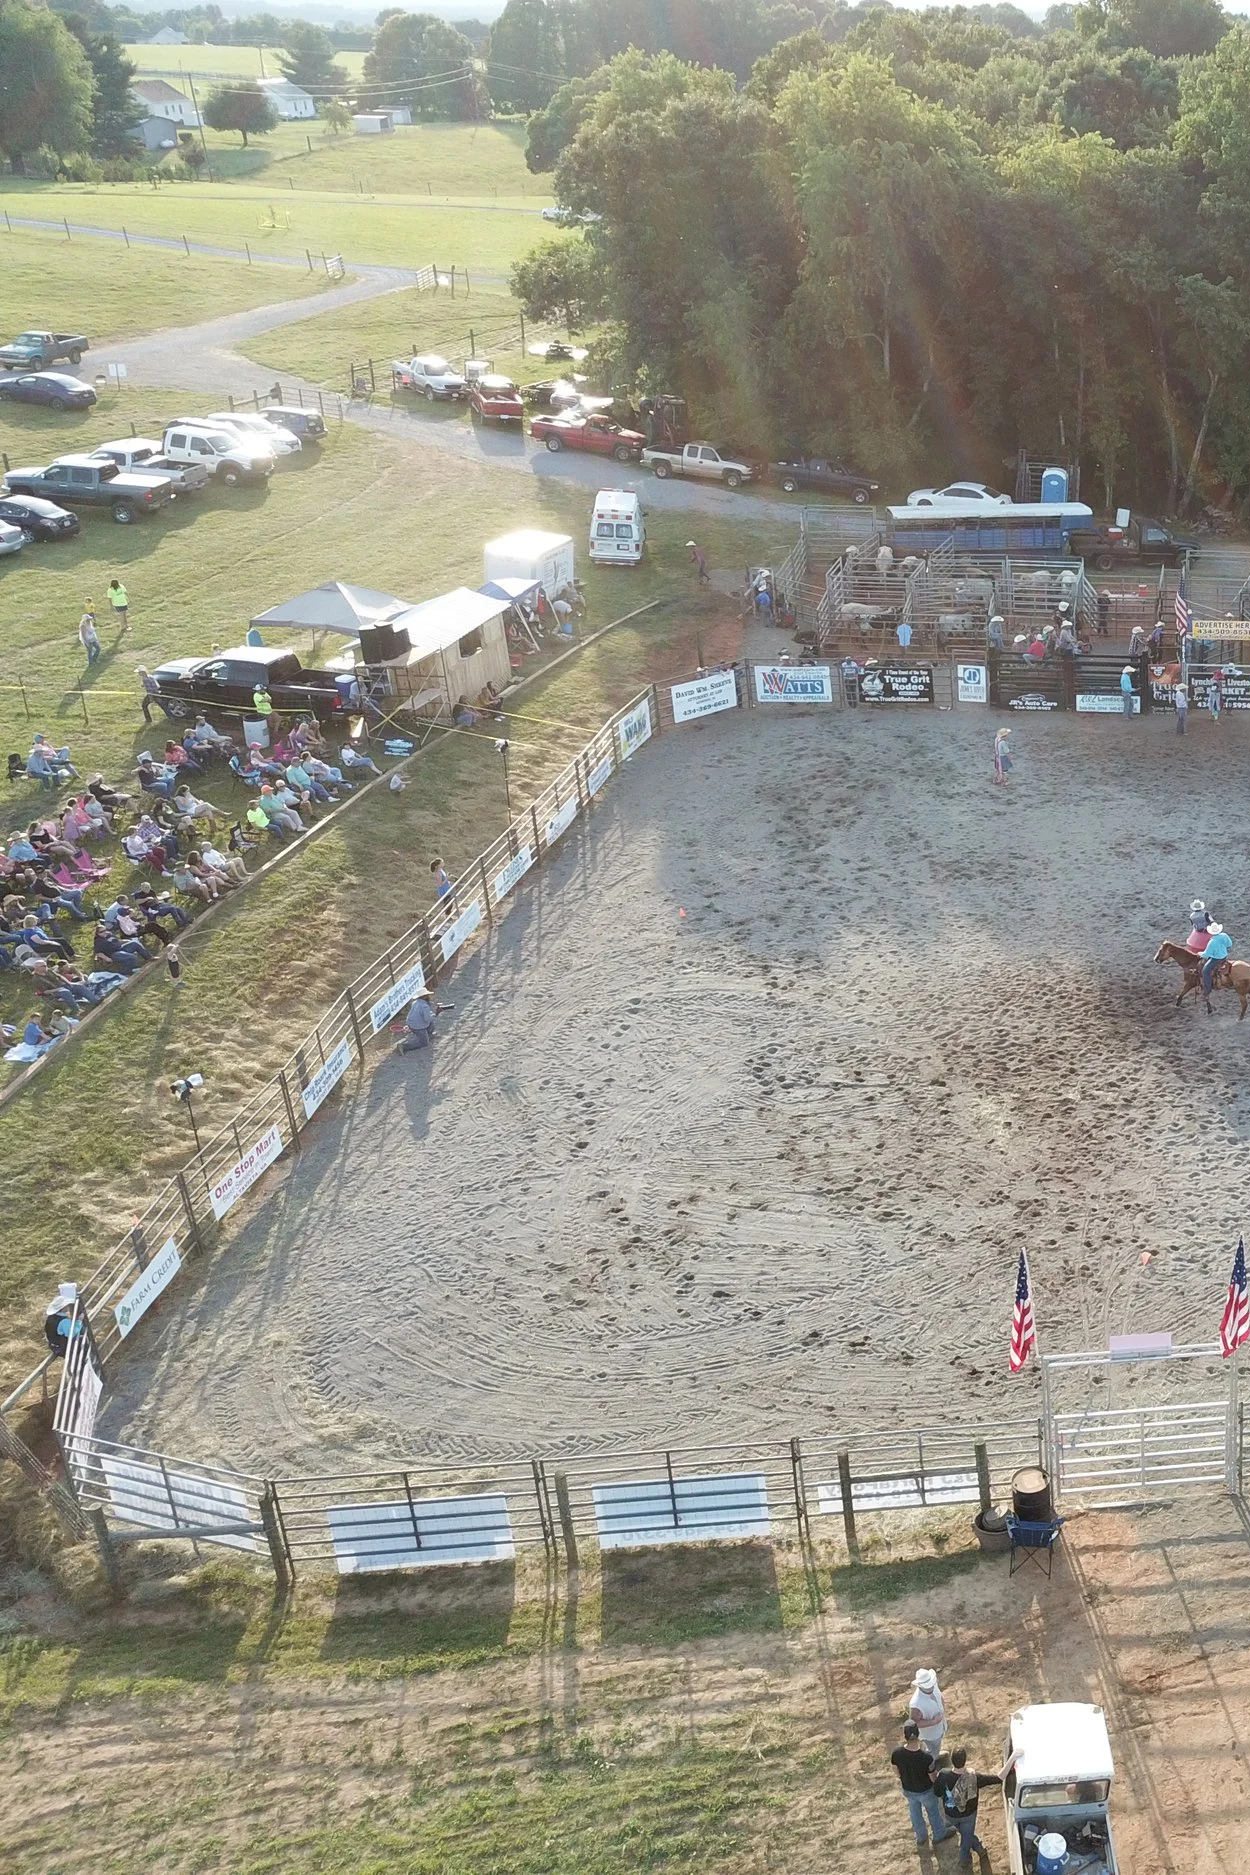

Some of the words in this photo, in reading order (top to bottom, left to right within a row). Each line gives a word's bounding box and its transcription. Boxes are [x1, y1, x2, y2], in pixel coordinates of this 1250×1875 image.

[676, 690, 695, 699] DAVID
[761, 672, 822, 695] WATTS
[892, 683, 924, 691] Rodeo
[215, 1178, 233, 1199] One
[234, 1155, 255, 1179] Stop
[256, 1131, 276, 1156] Mart
[131, 1284, 152, 1311] FARM
[152, 1251, 177, 1285] CREDIT
